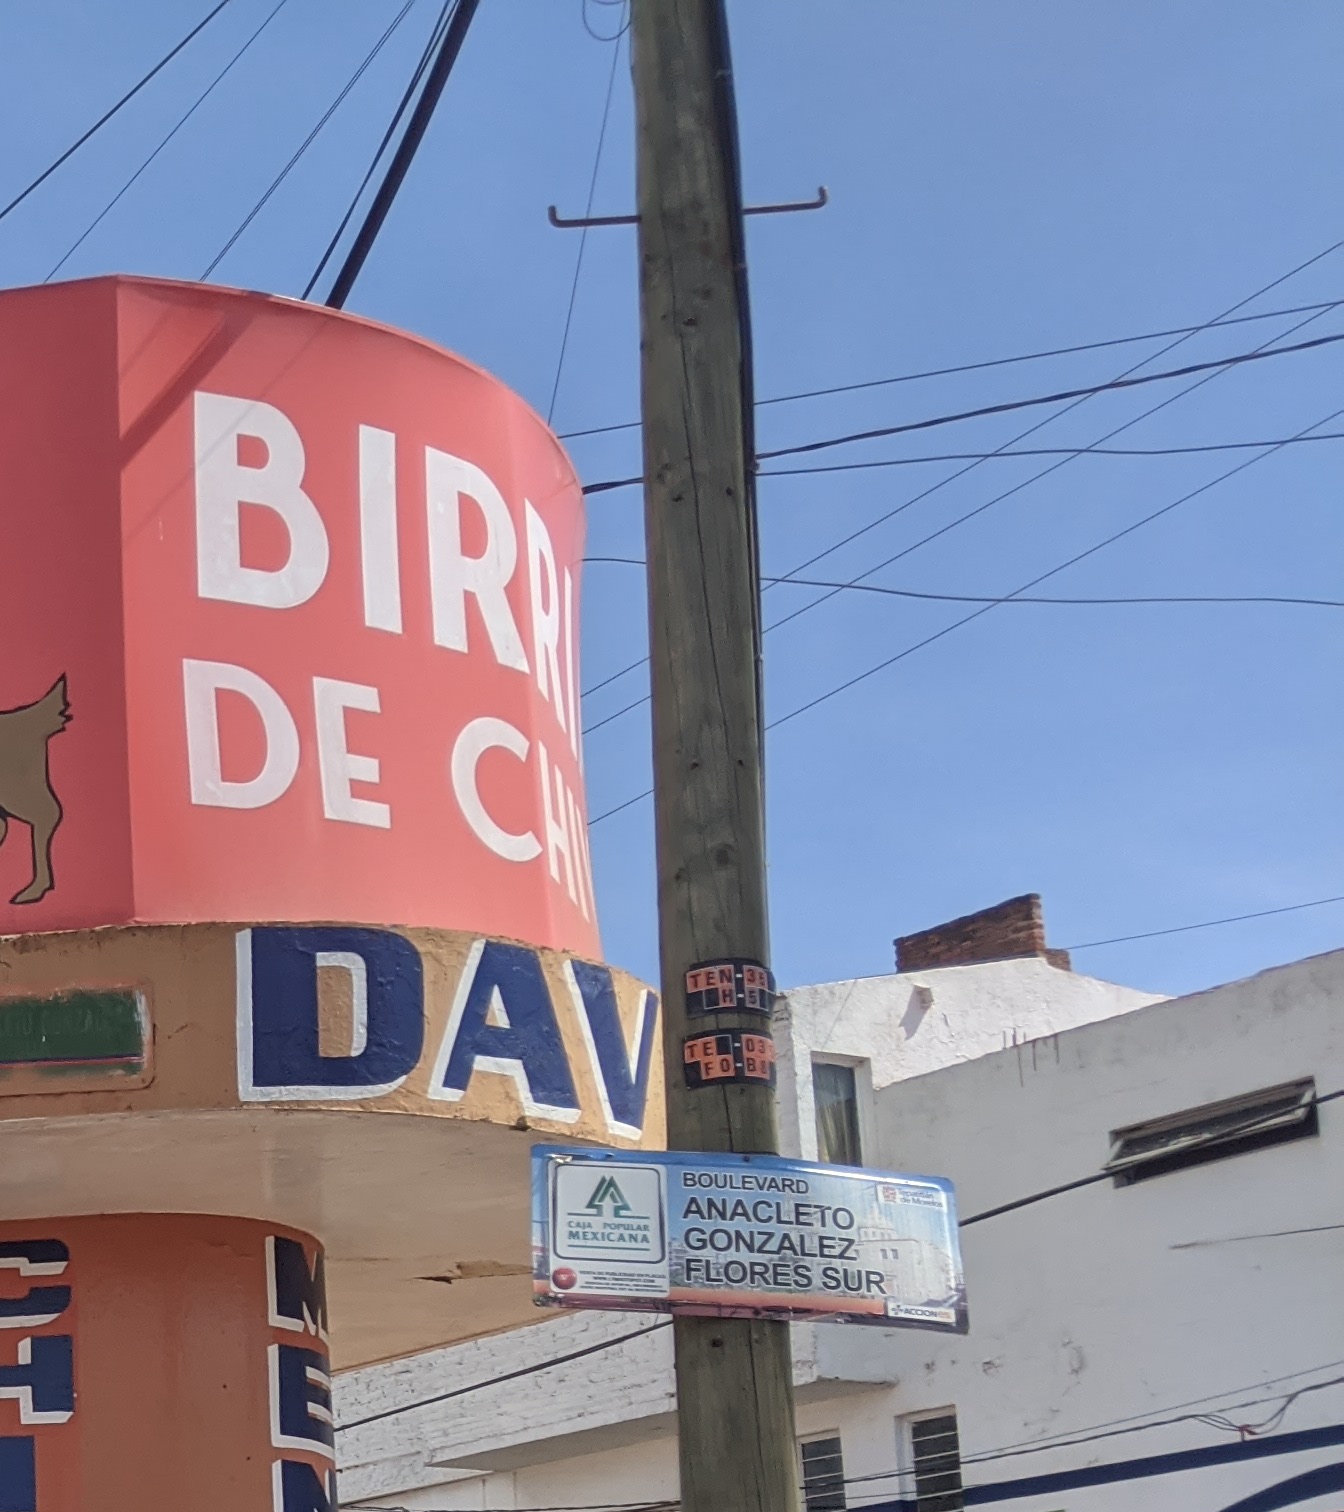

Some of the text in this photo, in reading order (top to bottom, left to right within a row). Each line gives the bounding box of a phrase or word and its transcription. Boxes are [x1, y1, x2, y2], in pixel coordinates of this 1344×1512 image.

[194, 391, 582, 765] BIRRI
[183, 658, 392, 829] DE
[682, 1172, 809, 1194] BOULEVARD
[568, 1221, 650, 1232] CAJA POPULAR
[682, 1197, 855, 1230] ANACLETO
[568, 1230, 650, 1244] MEXICANA
[684, 1227, 857, 1261] GONZALEZ
[685, 1258, 887, 1295] FLORES SUR
